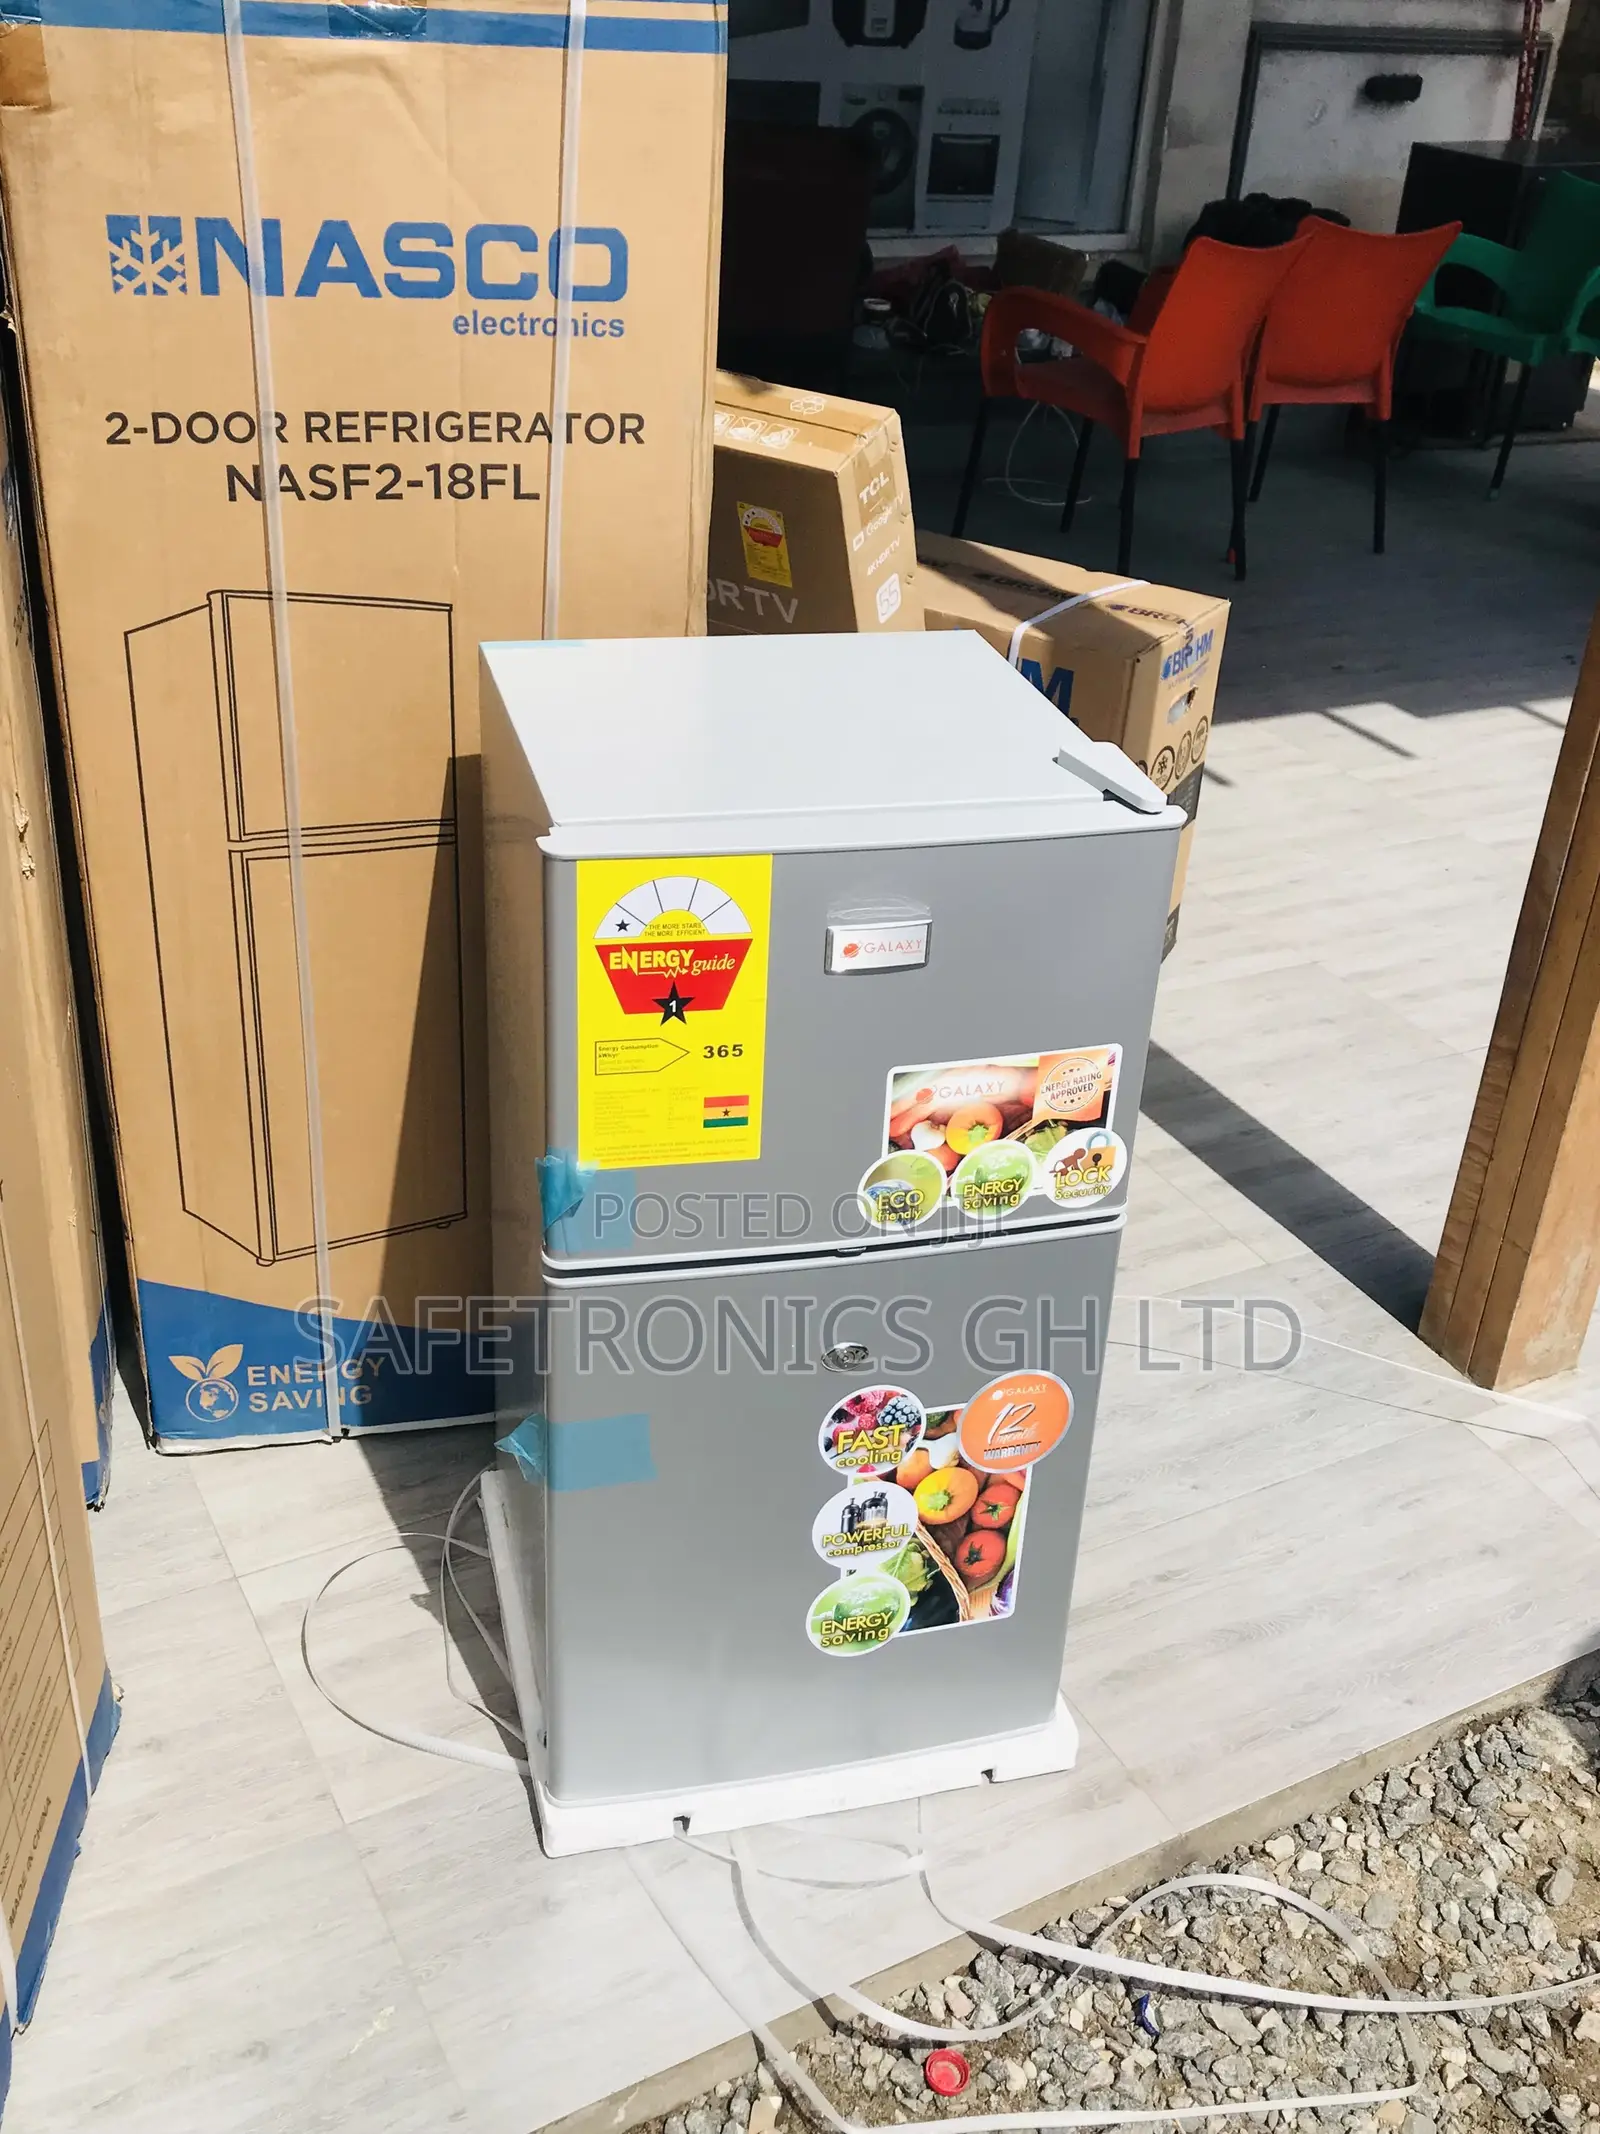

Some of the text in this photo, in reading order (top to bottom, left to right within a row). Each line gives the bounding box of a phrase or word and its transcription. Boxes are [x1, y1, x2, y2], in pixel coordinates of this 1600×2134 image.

[195, 216, 628, 303] NASCO
[304, 410, 645, 445] REFRIGERATOR
[226, 462, 540, 502] NASF2-18FL
[859, 471, 890, 505] TCL
[1171, 628, 1214, 677] BRHM
[864, 939, 923, 954] GALAXY
[609, 946, 736, 976] ENERGY guide
[669, 1000, 677, 1013] 1
[703, 1044, 744, 1059] 365
[939, 1080, 1006, 1099] GALAXY
[1050, 1082, 1095, 1102] APPROVED
[963, 1176, 1024, 1198] ENERGY
[1054, 1165, 1113, 1189] LOCK
[877, 1189, 925, 1210] ECO
[963, 1192, 1021, 1211] saving
[1055, 1184, 1112, 1201] Security
[877, 1206, 922, 1223] friendly
[1006, 1383, 1048, 1396] GALAXY
[836, 1424, 907, 1455] FAST
[836, 1450, 902, 1469] cooling
[822, 1523, 912, 1548] POWERFUL
[827, 1539, 902, 1557] compressor
[821, 1611, 894, 1635] ENERGY
[821, 1627, 890, 1648] saving
